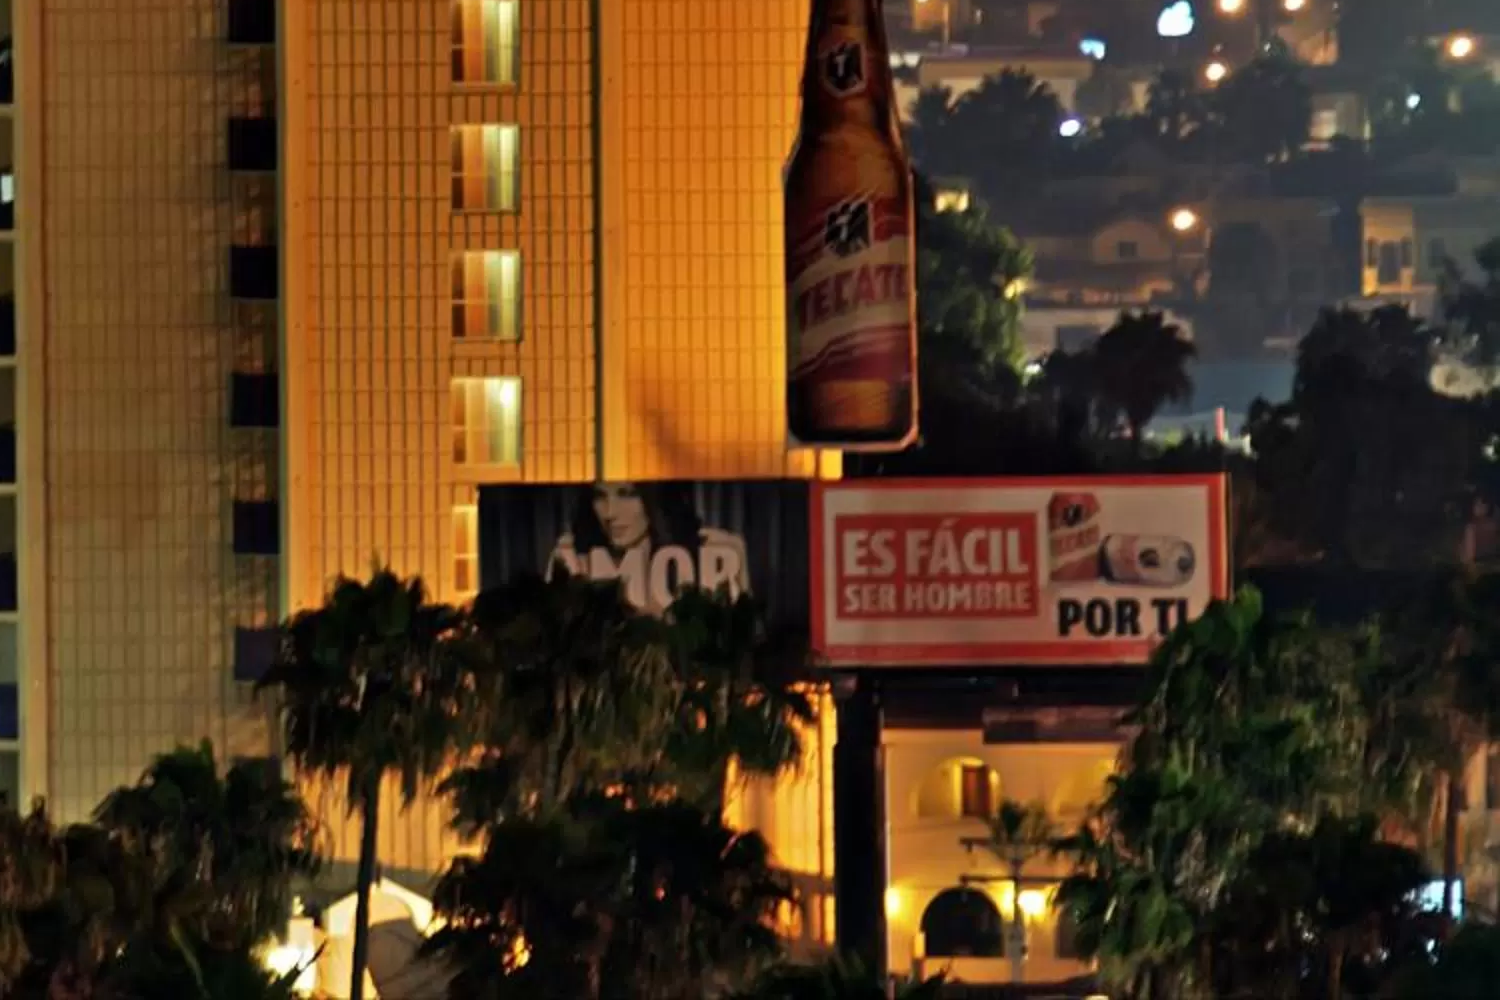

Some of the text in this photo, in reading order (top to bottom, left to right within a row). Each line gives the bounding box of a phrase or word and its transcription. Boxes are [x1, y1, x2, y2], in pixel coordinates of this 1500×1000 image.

[842, 529, 896, 577] ES
[905, 518, 1029, 576] FÁCIL
[844, 581, 1031, 613] SER HOMBRE
[1058, 597, 1189, 637] POR TI
